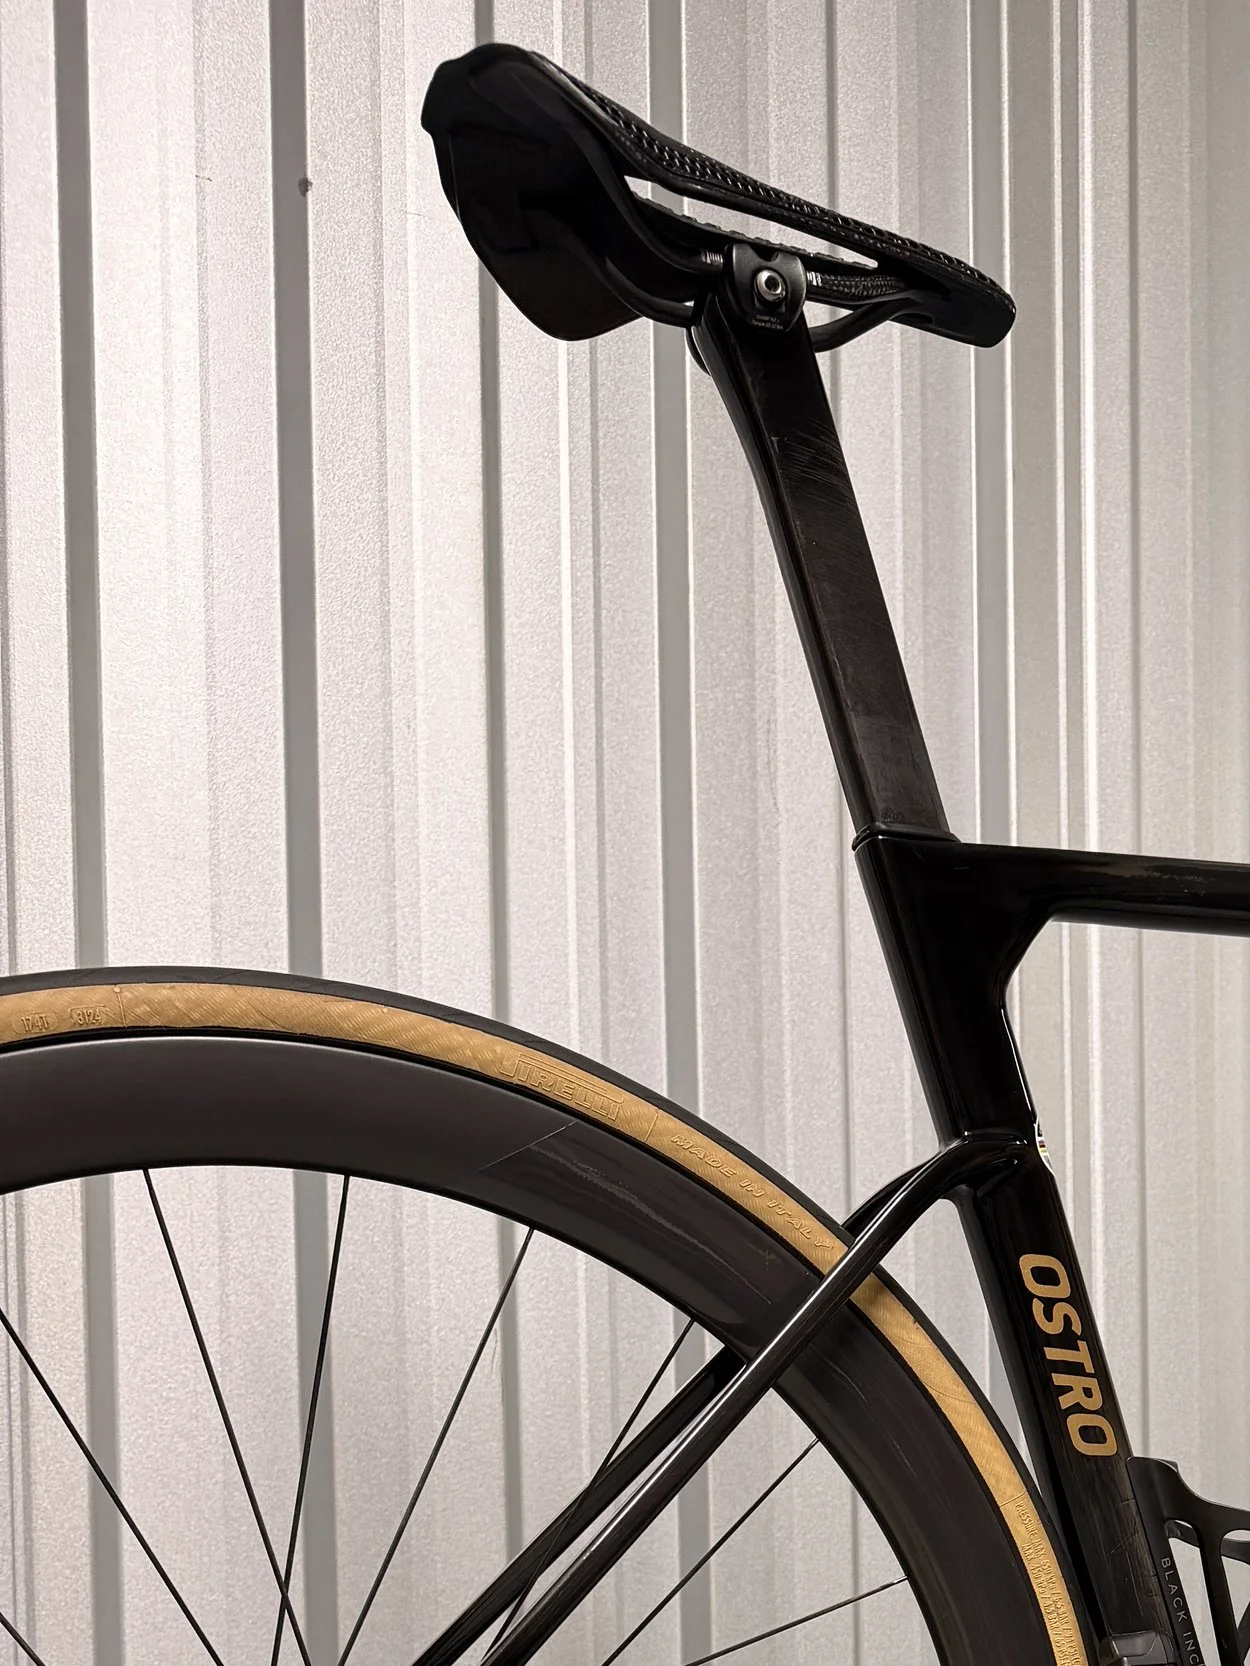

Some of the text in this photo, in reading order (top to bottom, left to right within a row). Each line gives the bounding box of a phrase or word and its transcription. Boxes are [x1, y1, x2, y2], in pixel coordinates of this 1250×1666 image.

[500, 1054, 624, 1121] PIRELLI
[670, 1133, 832, 1251] MADE IN ITALY
[1018, 1253, 1119, 1457] OSTRO
[1161, 1557, 1200, 1666] BLACK INC
